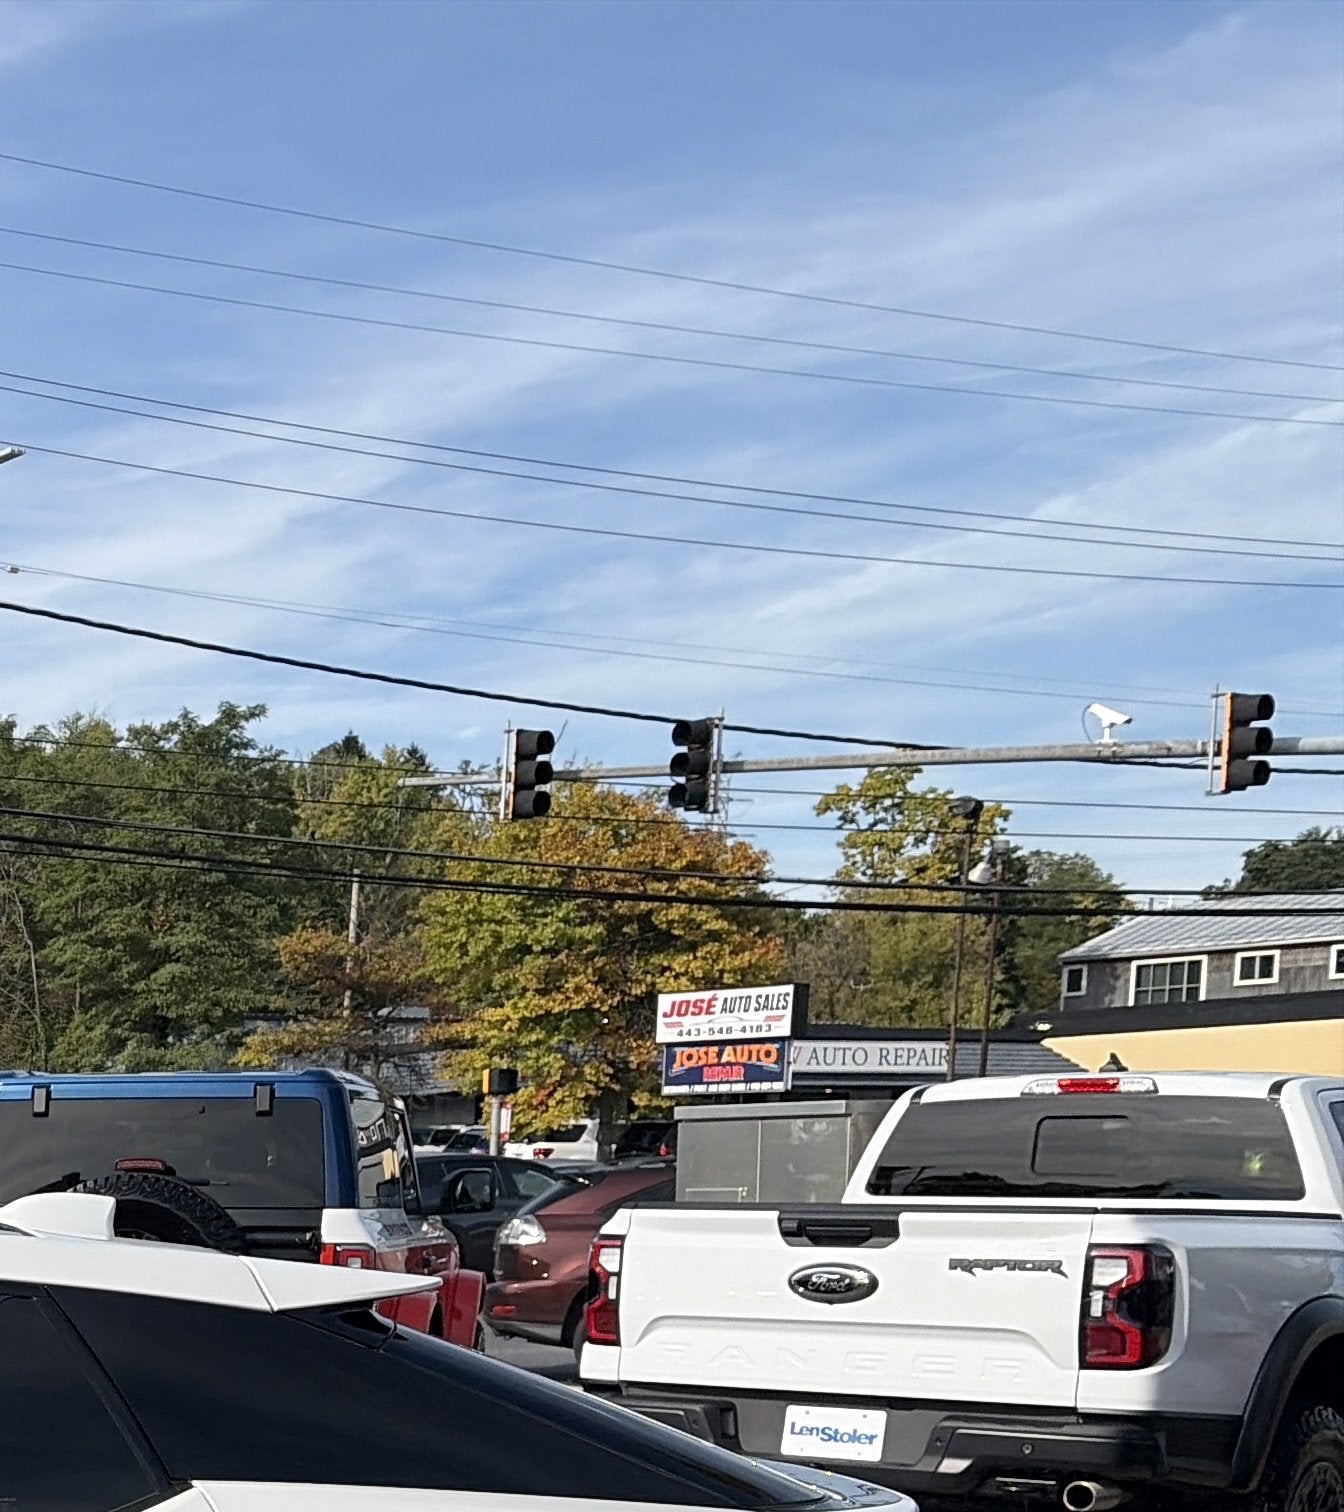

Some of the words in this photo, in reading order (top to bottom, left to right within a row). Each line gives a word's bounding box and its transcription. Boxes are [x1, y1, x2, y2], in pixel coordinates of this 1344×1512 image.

[662, 993, 719, 1018] JOSÉ
[720, 995, 752, 1014] AUTO
[754, 991, 790, 1012] SALES
[721, 1043, 778, 1065] AUTO
[807, 1047, 869, 1066] AUTO
[878, 1047, 949, 1066] REPAIR
[948, 1258, 1069, 1279] RAPTOR
[807, 1273, 849, 1293] Ford
[660, 1343, 1026, 1380] RANGER
